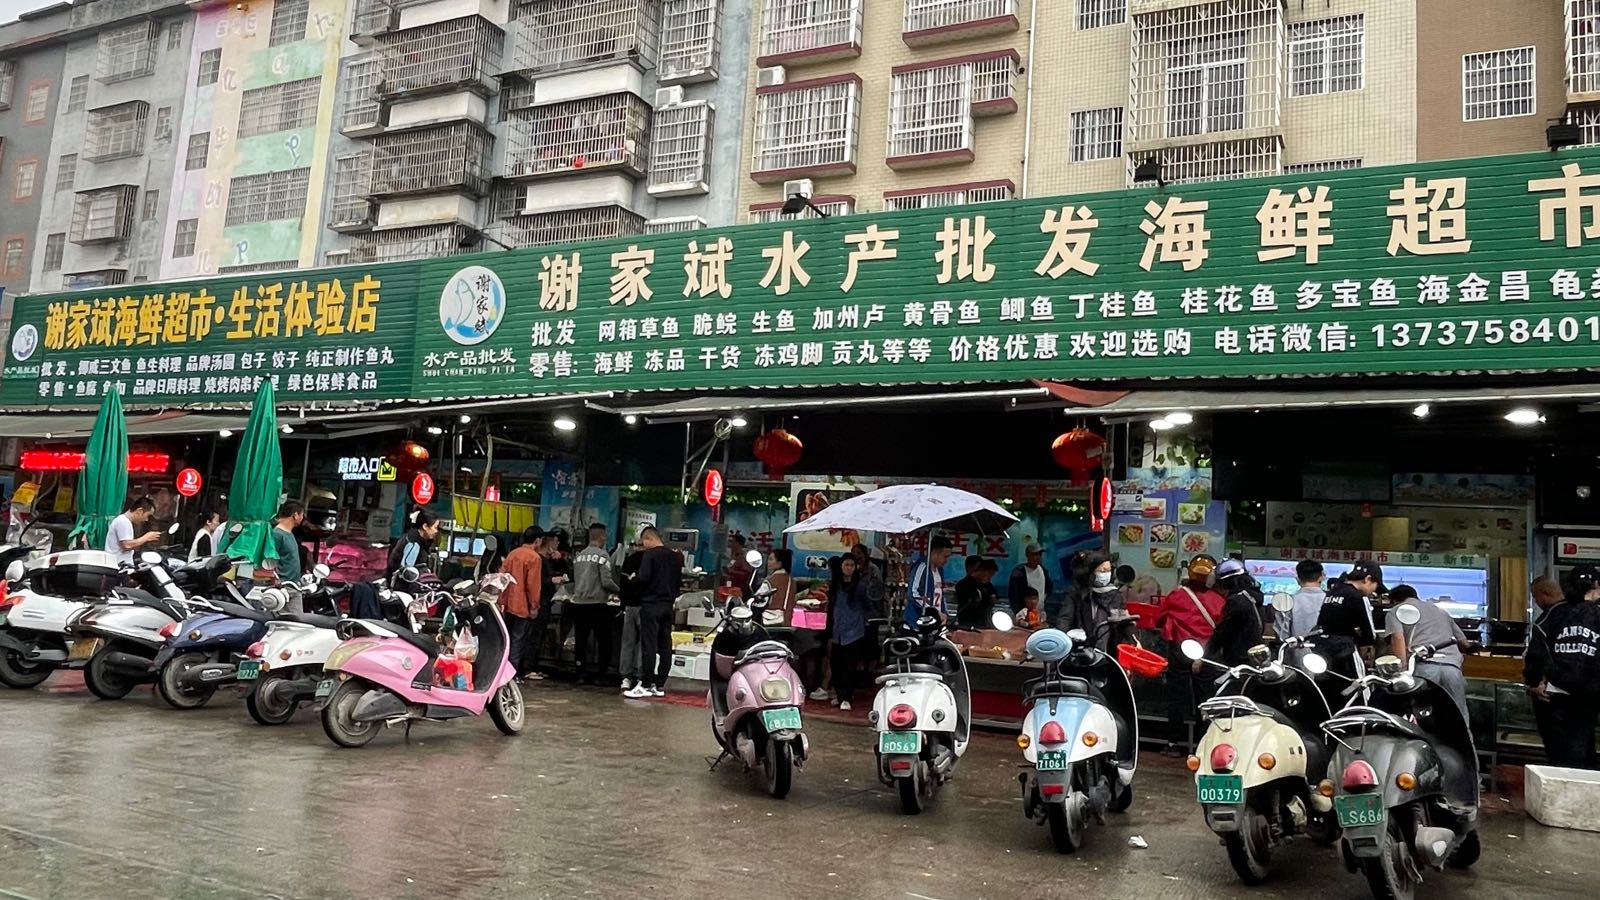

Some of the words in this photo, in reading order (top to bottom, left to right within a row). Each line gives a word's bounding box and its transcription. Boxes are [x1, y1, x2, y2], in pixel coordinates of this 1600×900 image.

[538, 164, 1600, 311] 谢家斌水产批发海鲜超市
[532, 320, 575, 346] 批发
[599, 317, 679, 341] 网箱草鱼
[752, 310, 795, 332] 生鱼
[813, 304, 885, 329] 加州卢
[904, 300, 980, 326] 黄骨鱼
[1000, 296, 1054, 321] 鲫鱼
[1069, 290, 1157, 318] 丁桂鱼
[1181, 284, 1277, 313] 桂花鱼
[1296, 278, 1399, 309] 多宝鱼
[1418, 271, 1529, 303] 海金昌
[595, 351, 633, 373] 海鲜
[645, 349, 684, 371] 冻品
[699, 346, 740, 368] 干货
[755, 343, 822, 367] 冻鸡脚
[833, 338, 931, 364] 贡丸等等
[949, 333, 1058, 361] 价格优惠
[1070, 328, 1190, 357] 欢迎选购
[1215, 322, 1355, 353] 电话微信:
[1372, 317, 1598, 346] 1373758401
[136, 356, 182, 373] 鱼生料理
[241, 352, 266, 370] 包子
[272, 351, 300, 369] 饺子
[306, 346, 395, 368] 纯正制作鱼丸
[423, 348, 517, 368] 水产品批发
[287, 371, 378, 392] 绿色保鲜食品
[338, 457, 378, 474] 超市入口
[1200, 788, 1240, 801] 00379
